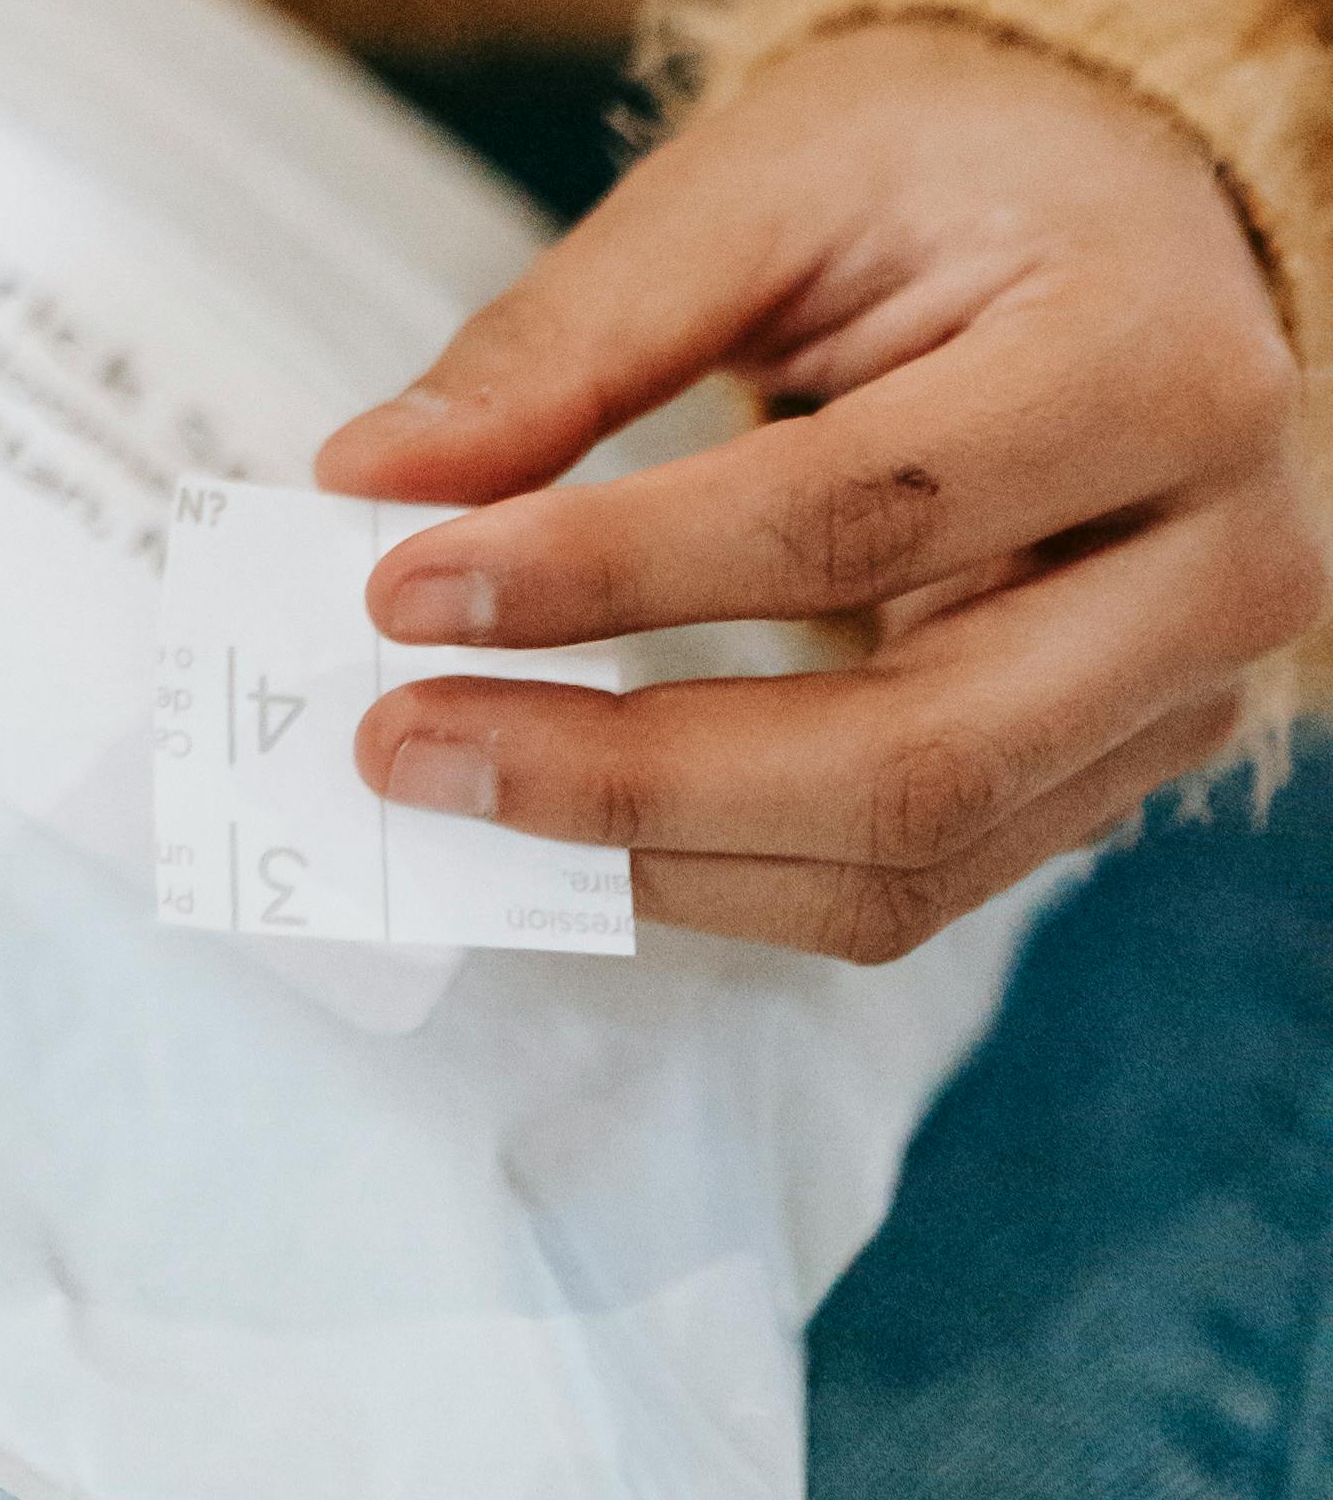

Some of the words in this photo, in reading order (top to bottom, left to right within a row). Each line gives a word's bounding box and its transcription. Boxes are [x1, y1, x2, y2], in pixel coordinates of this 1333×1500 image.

[175, 486, 229, 528] N?
[246, 673, 309, 754] 4
[258, 845, 310, 928] 3
